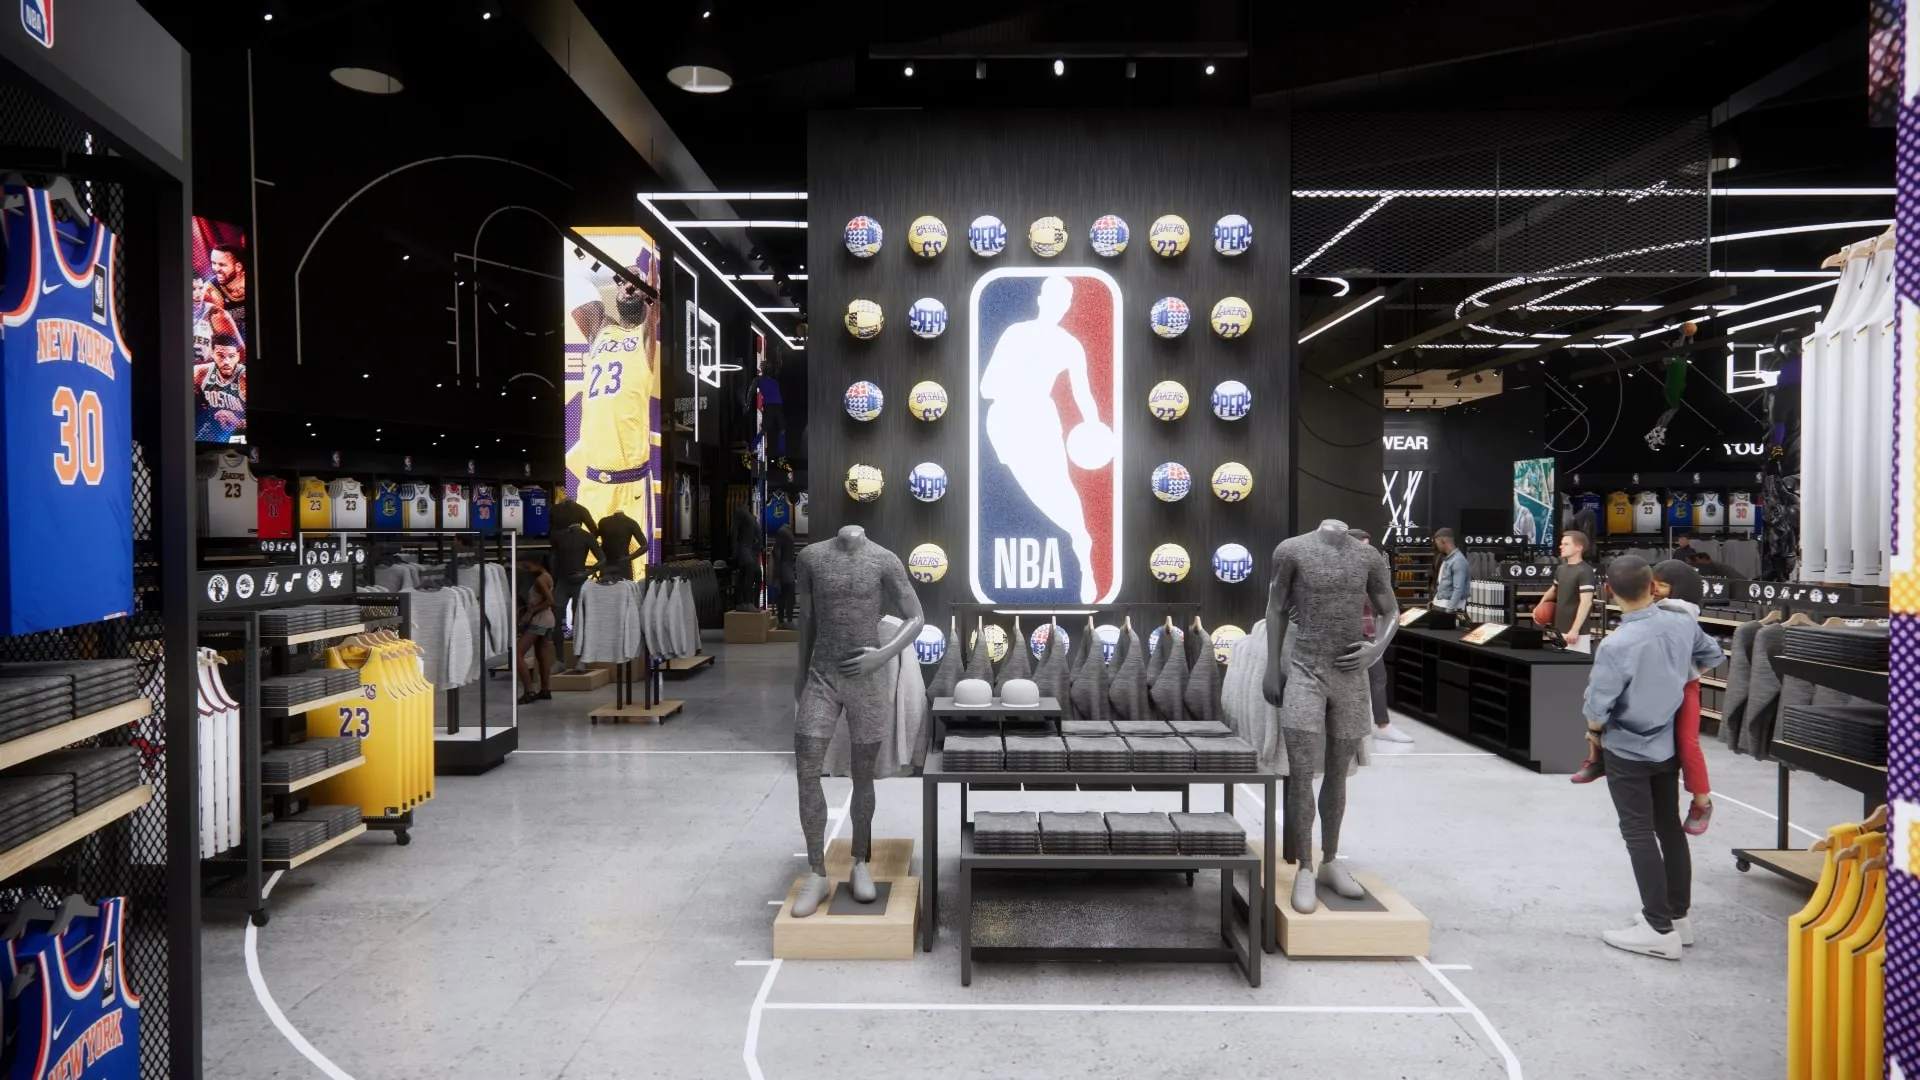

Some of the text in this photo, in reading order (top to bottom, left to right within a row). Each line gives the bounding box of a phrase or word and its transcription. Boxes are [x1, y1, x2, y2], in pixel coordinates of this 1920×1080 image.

[26, 4, 42, 34] NBA
[37, 318, 115, 380] NEW YORK
[588, 361, 623, 399] 23
[52, 386, 105, 485] 30
[224, 483, 242, 498] 23
[310, 500, 322, 511] 23
[345, 500, 357, 511] 23
[447, 504, 459, 518] 30
[1616, 507, 1625, 515] 23
[1643, 506, 1653, 515] 23
[1735, 507, 1747, 519] 30
[994, 537, 1063, 589] NBA
[339, 707, 370, 738] 23
[83, 1008, 123, 1068] YORK
